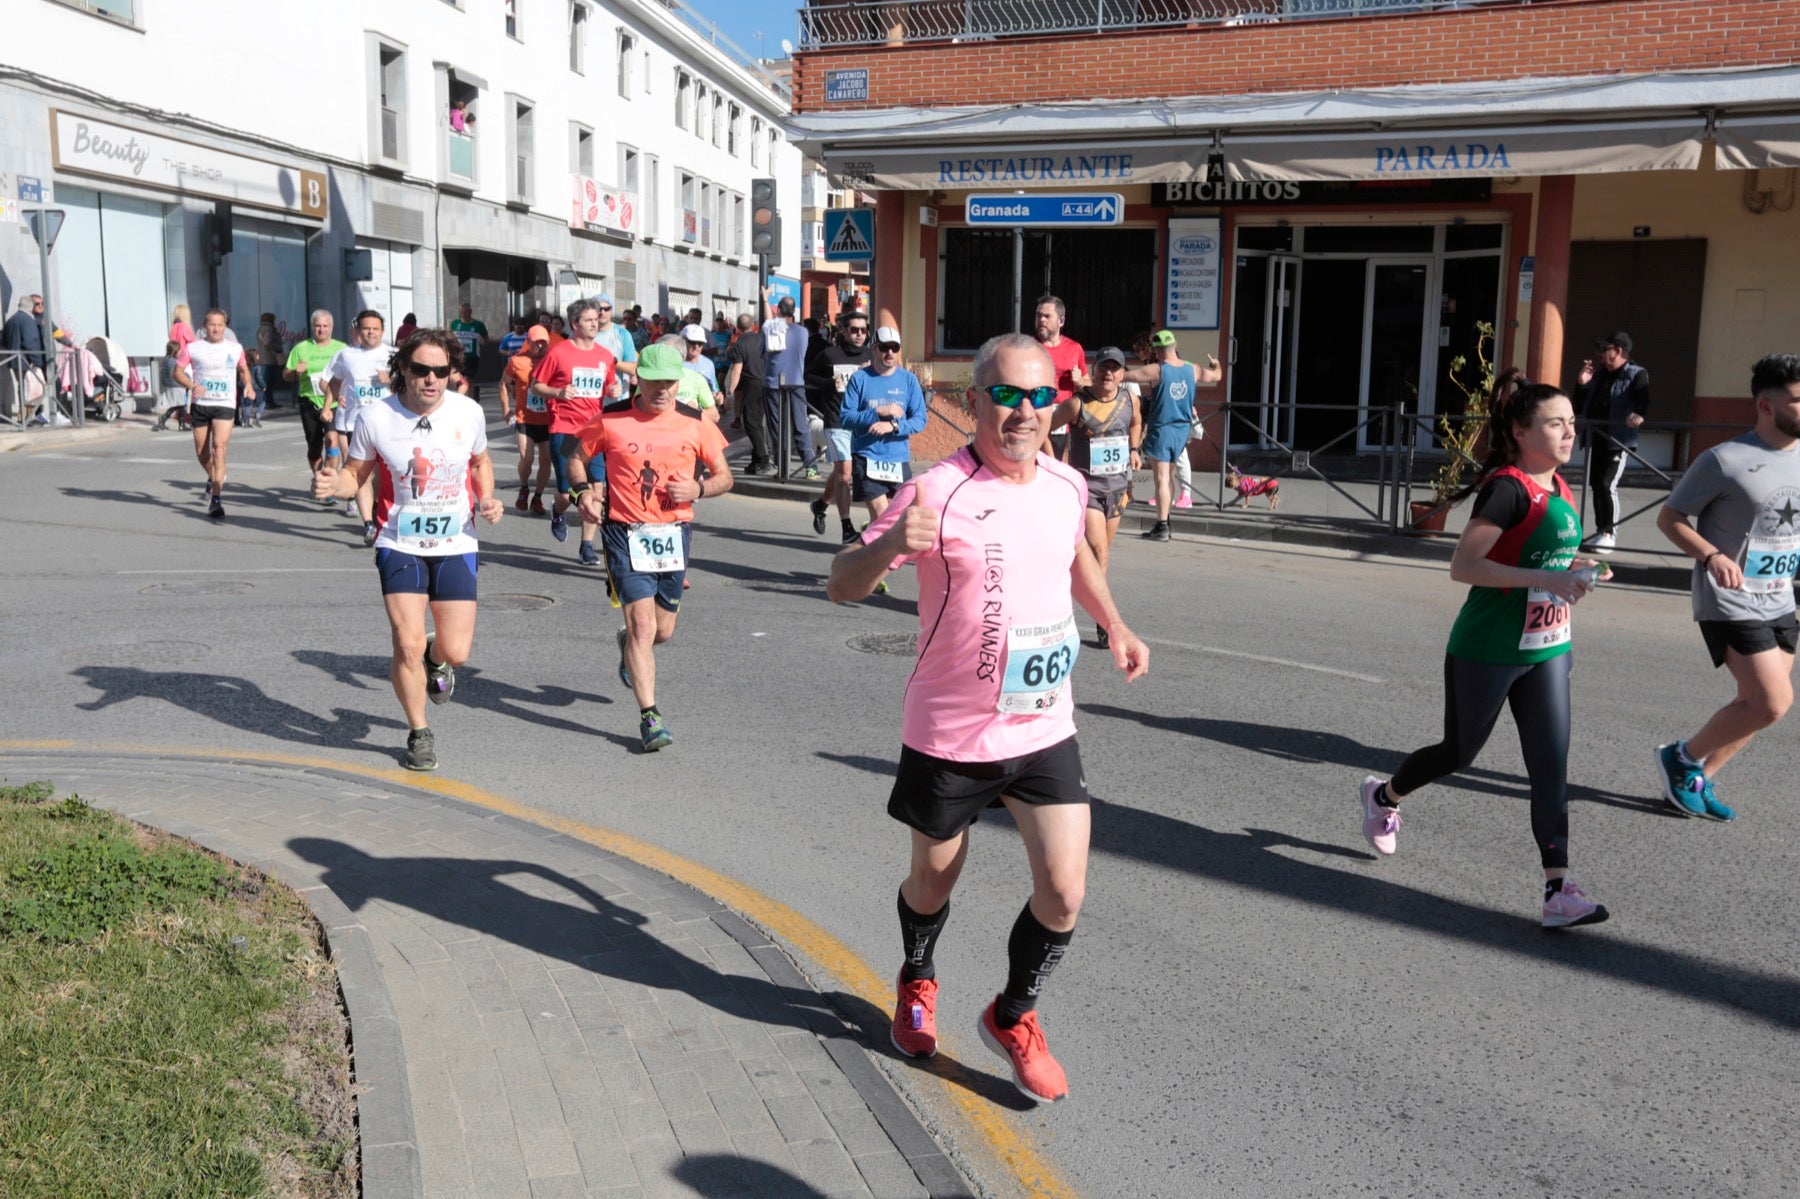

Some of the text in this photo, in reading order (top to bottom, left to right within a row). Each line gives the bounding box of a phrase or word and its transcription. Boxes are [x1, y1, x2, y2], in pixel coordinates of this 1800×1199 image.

[836, 71, 866, 80] AVENIDA
[838, 79, 864, 89] JACOBO
[828, 89, 866, 100] CAMARERO
[73, 123, 150, 176] Beauty
[1374, 143, 1511, 172] PARADA
[162, 158, 223, 182] THE SHOP
[938, 154, 1134, 183] RESTAURANTE
[308, 179, 320, 208] B
[1166, 181, 1300, 201] BICHITOS
[970, 204, 1092, 217] Granada A-44
[1179, 242, 1212, 250] PARADA
[206, 380, 227, 392] 979
[359, 387, 381, 398] 648
[574, 377, 602, 389] 1116
[1103, 448, 1120, 463] 35
[874, 461, 896, 473] 107
[411, 515, 452, 535] 157
[640, 536, 675, 556] 364
[1757, 553, 1797, 575] 268
[976, 543, 1004, 684] ILL@S RUNNERS
[1023, 645, 1071, 687] 663
